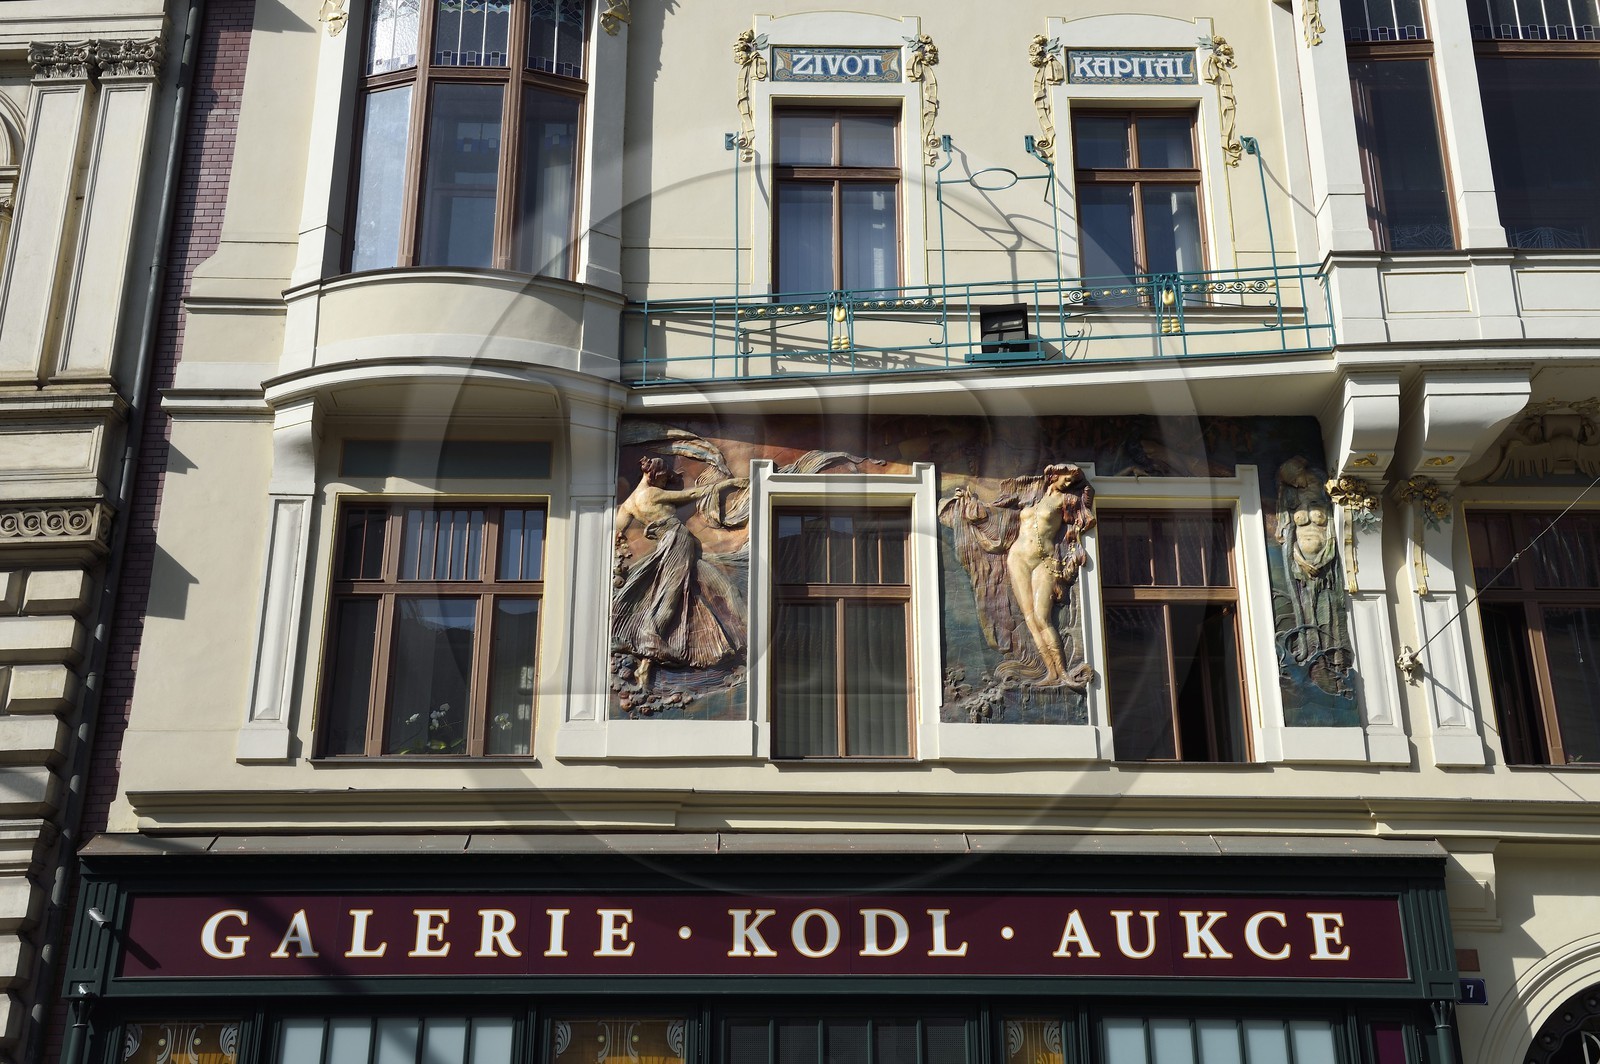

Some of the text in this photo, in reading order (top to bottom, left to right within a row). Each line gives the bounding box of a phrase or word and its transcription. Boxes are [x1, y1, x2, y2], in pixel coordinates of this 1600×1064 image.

[792, 50, 882, 75] ŽIVOT
[200, 908, 1351, 962] GALERIE KODL AUKCE
[1466, 984, 1474, 998] 7
